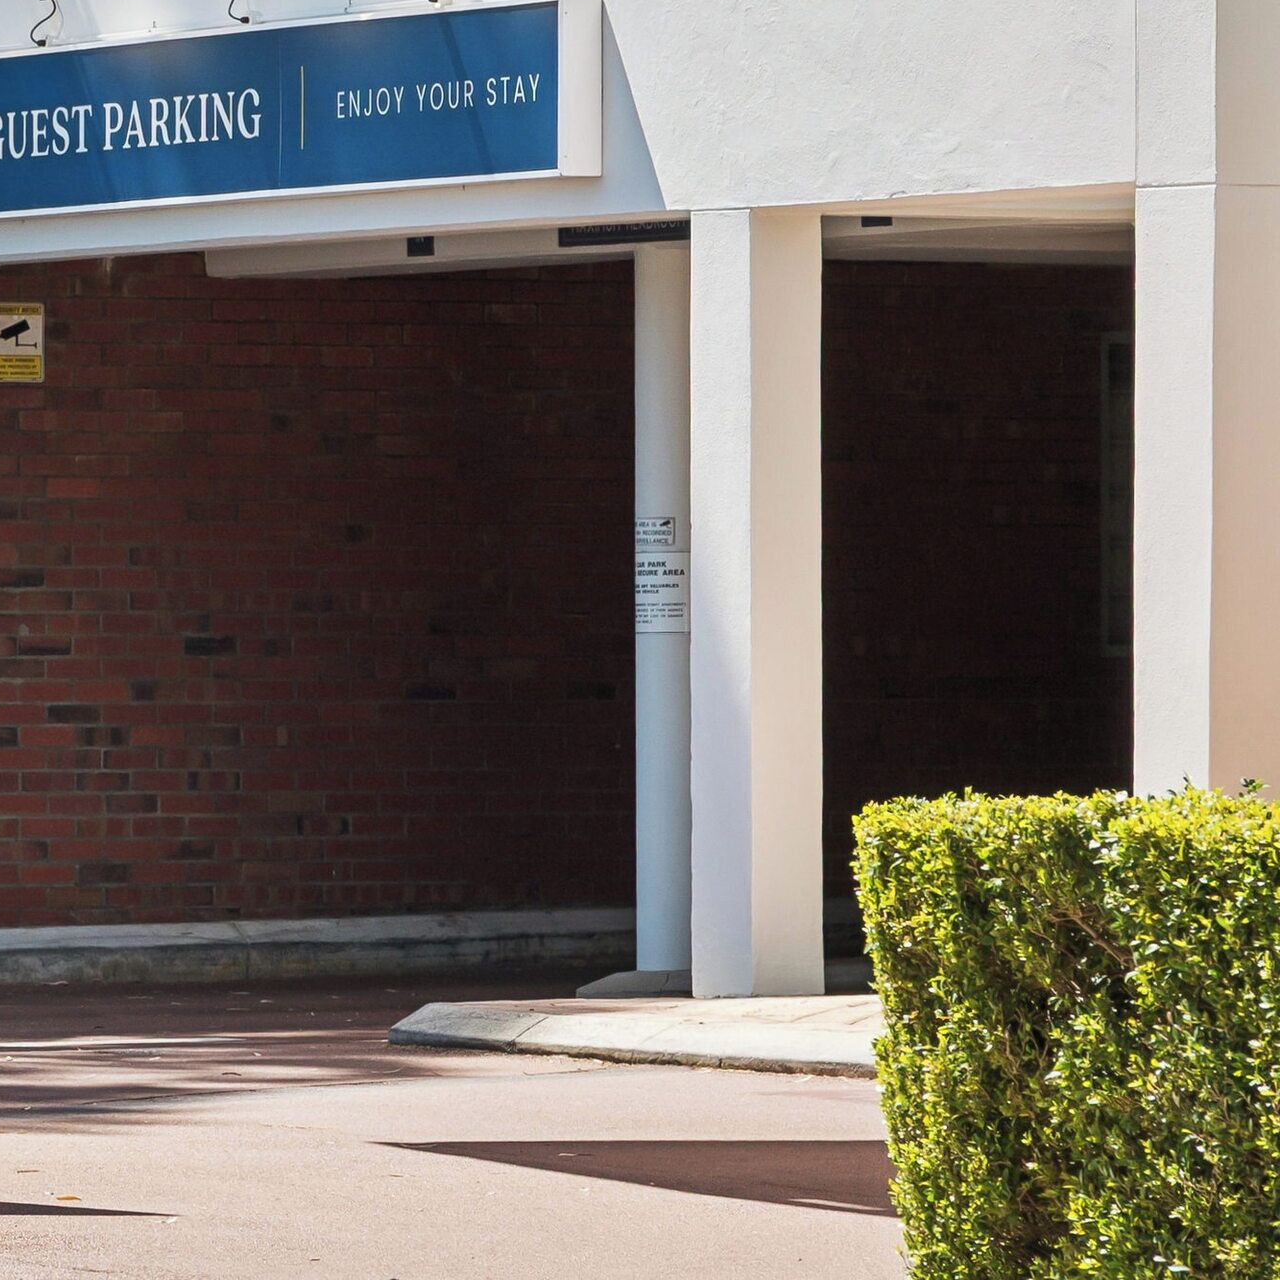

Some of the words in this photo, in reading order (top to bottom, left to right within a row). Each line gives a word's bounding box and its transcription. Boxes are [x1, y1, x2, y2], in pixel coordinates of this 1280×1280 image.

[103, 88, 262, 151] PARKING
[337, 86, 404, 119] ENJOY
[416, 80, 474, 111] YOUR
[486, 73, 540, 106] STAY
